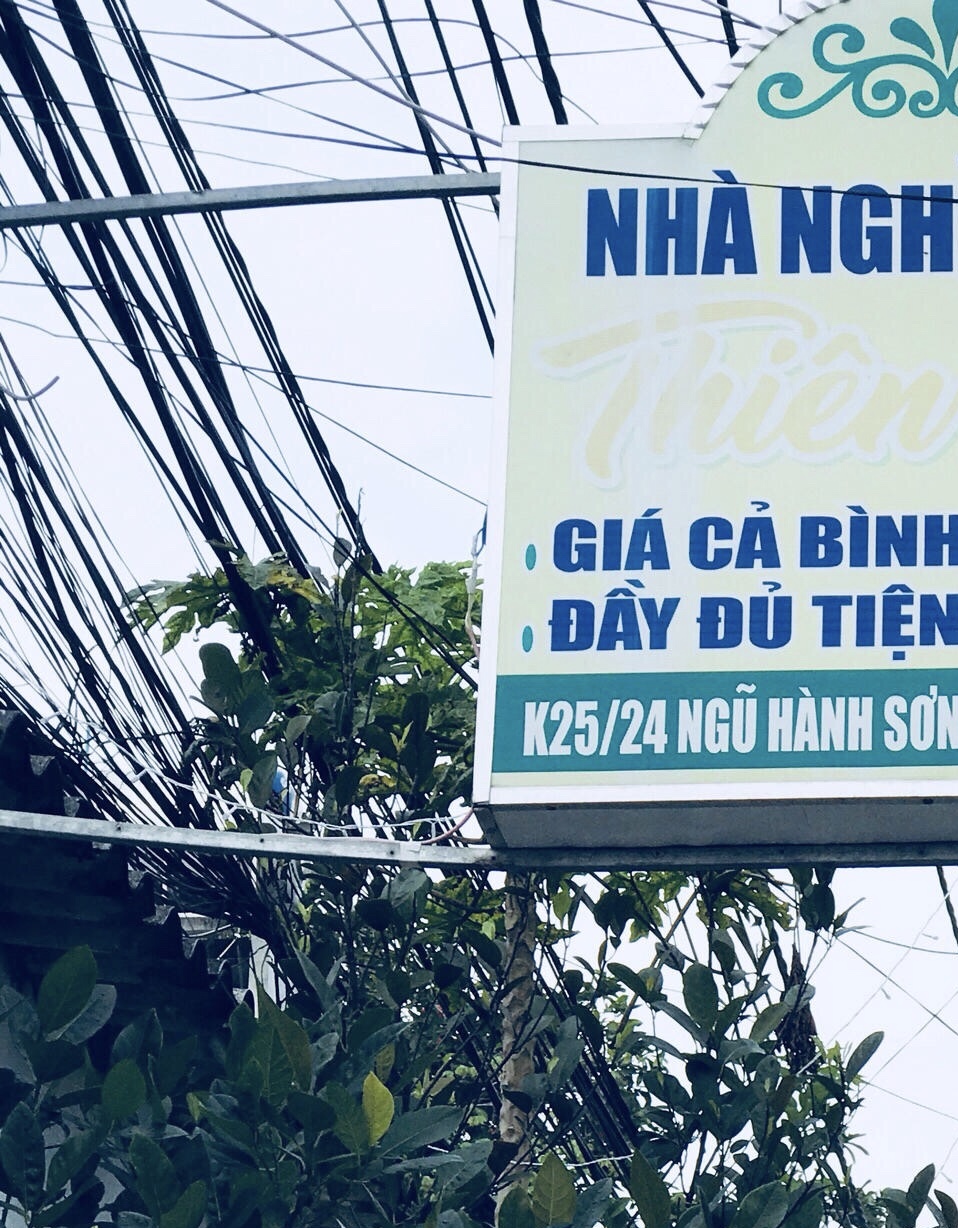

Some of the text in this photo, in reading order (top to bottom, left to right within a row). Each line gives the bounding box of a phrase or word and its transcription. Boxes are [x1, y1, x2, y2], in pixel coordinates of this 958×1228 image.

[586, 170, 758, 277] NHÀ
[553, 508, 670, 573] GIÁ
[688, 501, 781, 571] CẢ
[548, 579, 681, 652] ĐẦY
[696, 581, 793, 649] ĐỦ
[523, 699, 668, 756] K25/24
[677, 683, 757, 754] NGŨ
[767, 686, 873, 752] HÀNH
